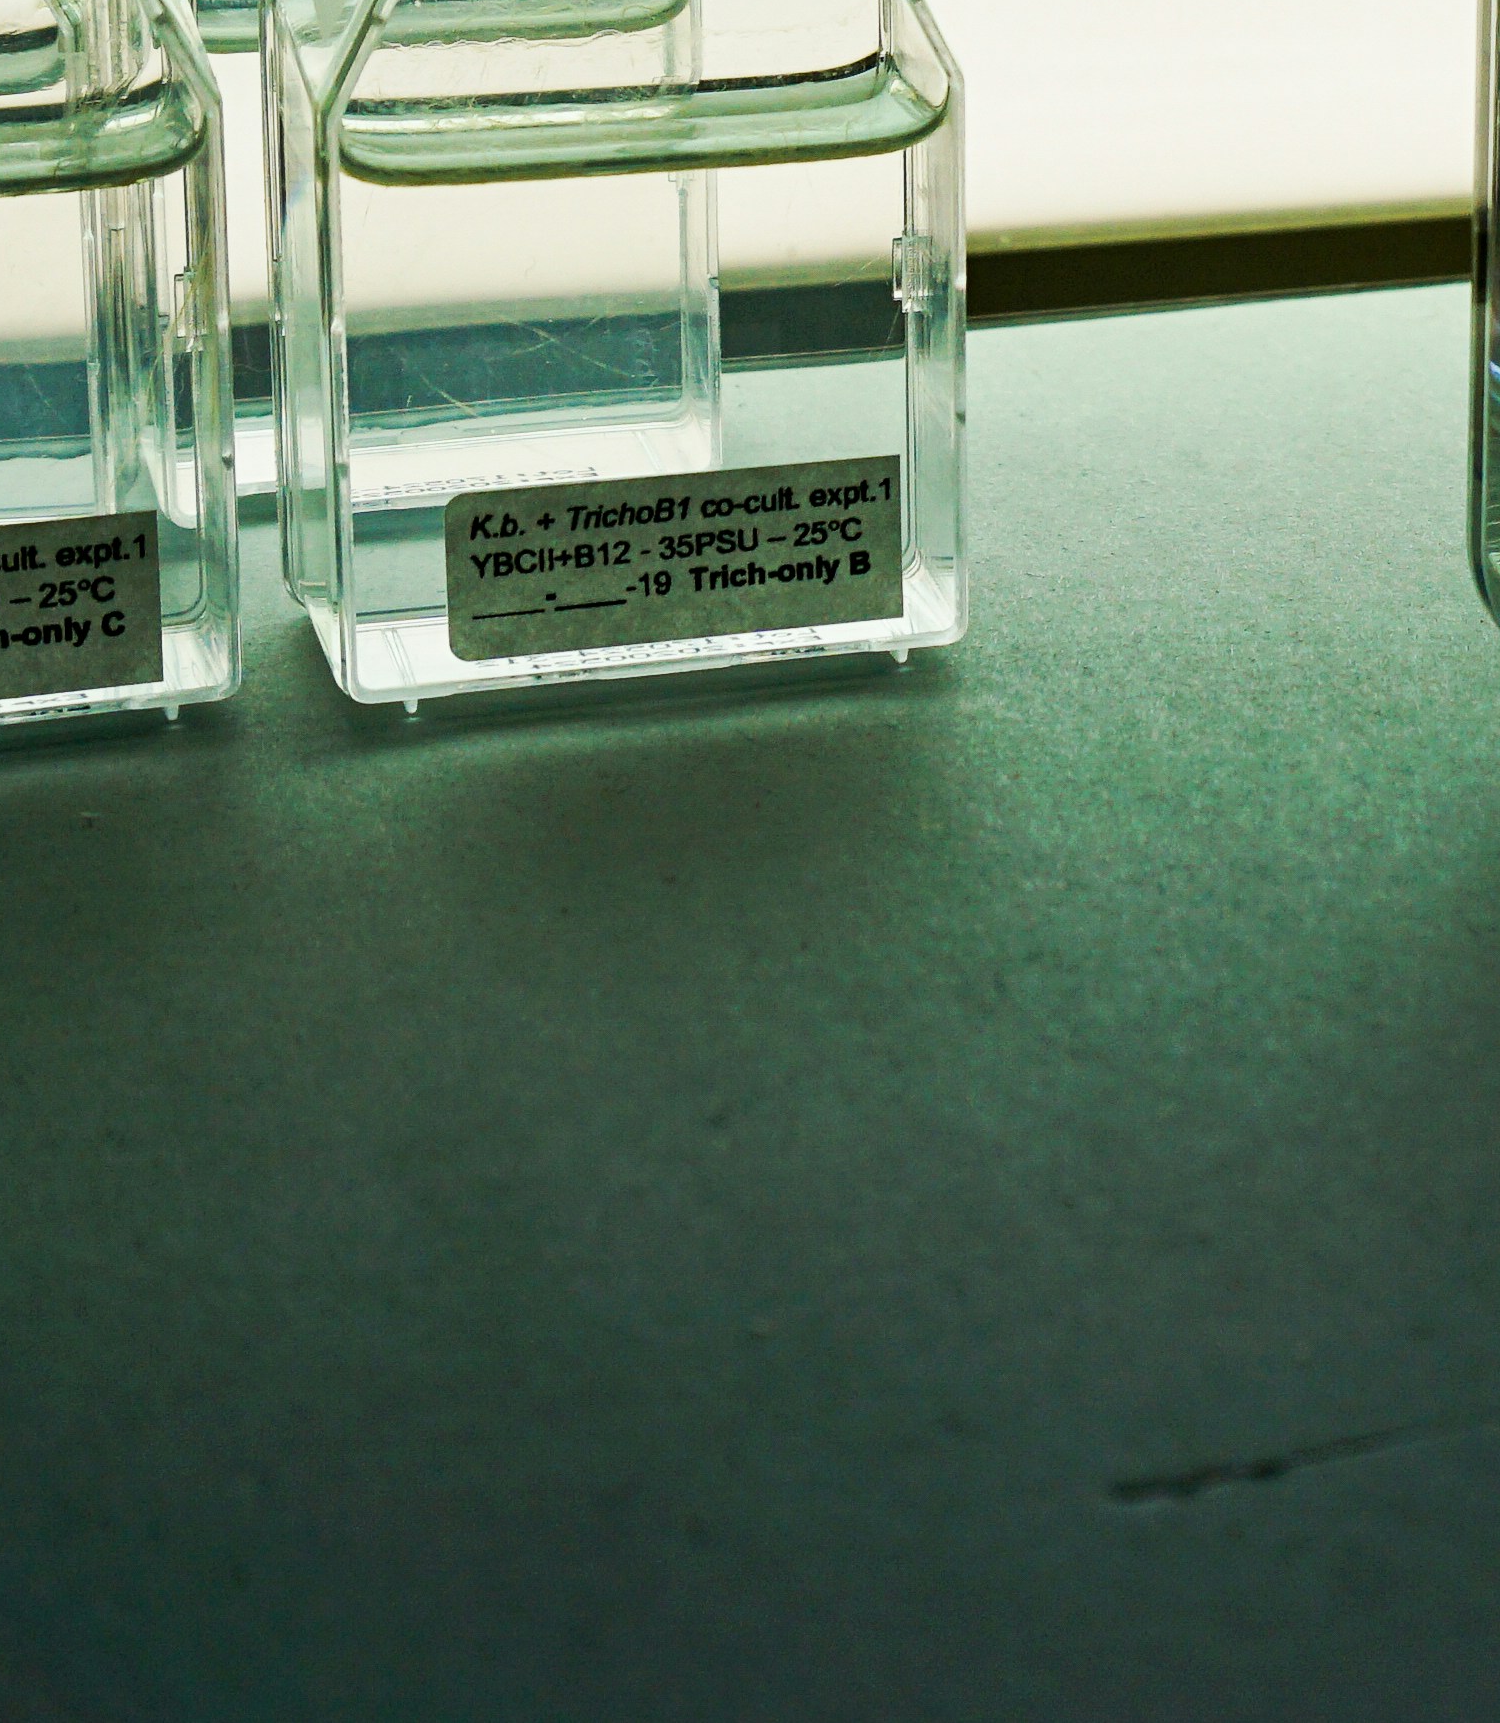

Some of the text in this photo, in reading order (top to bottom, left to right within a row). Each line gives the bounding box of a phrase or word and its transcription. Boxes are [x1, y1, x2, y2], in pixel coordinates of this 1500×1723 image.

[469, 513, 527, 540] K.b.
[537, 512, 555, 530] +
[566, 496, 691, 531] TrichoB1
[658, 527, 759, 560] 35PSU
[688, 554, 841, 592] Trich-only
[849, 550, 871, 576] B
[101, 610, 126, 637] C
